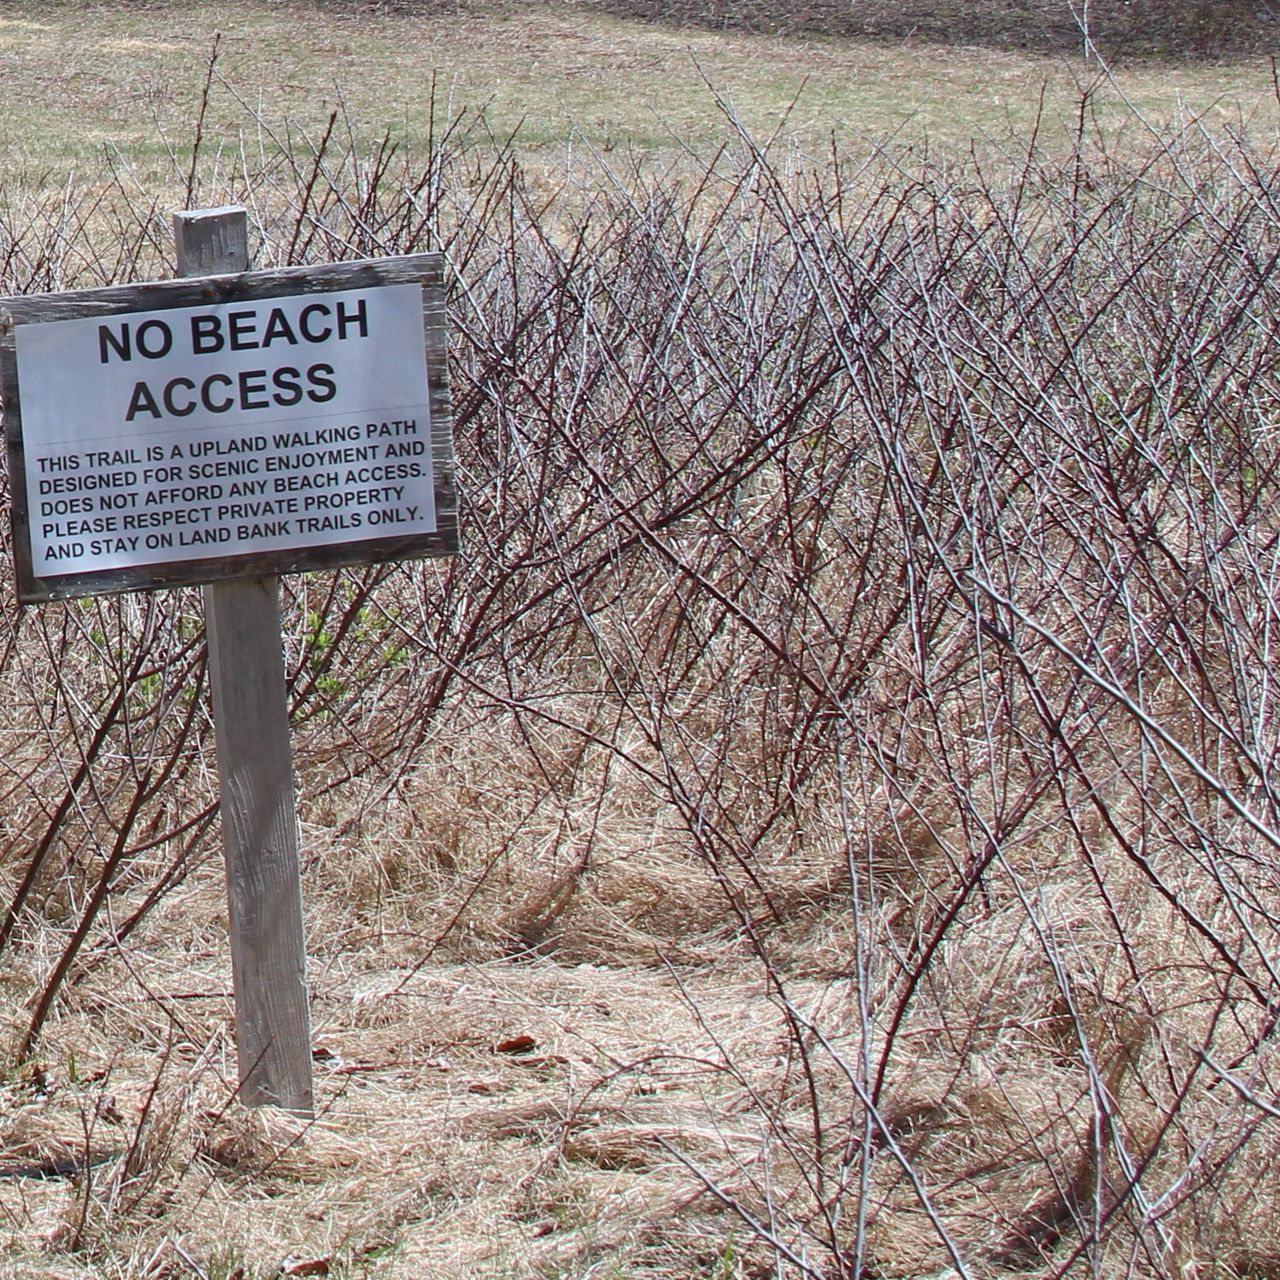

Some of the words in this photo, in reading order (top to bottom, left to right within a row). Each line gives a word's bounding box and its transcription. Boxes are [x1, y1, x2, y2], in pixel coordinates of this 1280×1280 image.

[98, 320, 172, 364] NO
[190, 298, 368, 355] BEACH
[125, 363, 336, 422] ACCESS
[37, 454, 80, 472] THIS
[86, 449, 141, 468] TRAIL
[146, 446, 164, 462] IS
[170, 444, 184, 460] A
[189, 436, 267, 458] UPLAND
[272, 426, 360, 449] WALKING
[366, 420, 416, 438] PATH
[39, 471, 137, 495] DESIGNED
[143, 466, 183, 484] FOR
[188, 459, 258, 480] SCENIC
[265, 444, 380, 472] ENJOYMENT
[384, 440, 425, 458] AND
[40, 497, 94, 517] DOES
[100, 492, 139, 510] NOT
[144, 484, 222, 506] AFFORD
[228, 479, 268, 498] ANY
[274, 472, 339, 493] BEACH
[344, 462, 426, 484] ACCESS.
[42, 516, 118, 538] PLEASE
[123, 507, 212, 530] RESPECT
[218, 498, 298, 520] PRIVATE
[304, 486, 405, 512] PROPERTY
[44, 542, 84, 561] AND
[90, 536, 140, 556] STAY
[146, 533, 173, 550] ON
[179, 528, 231, 546] LAND
[238, 521, 290, 540] BANK
[296, 512, 362, 534] TRAILS
[368, 506, 424, 525] ONLY.
